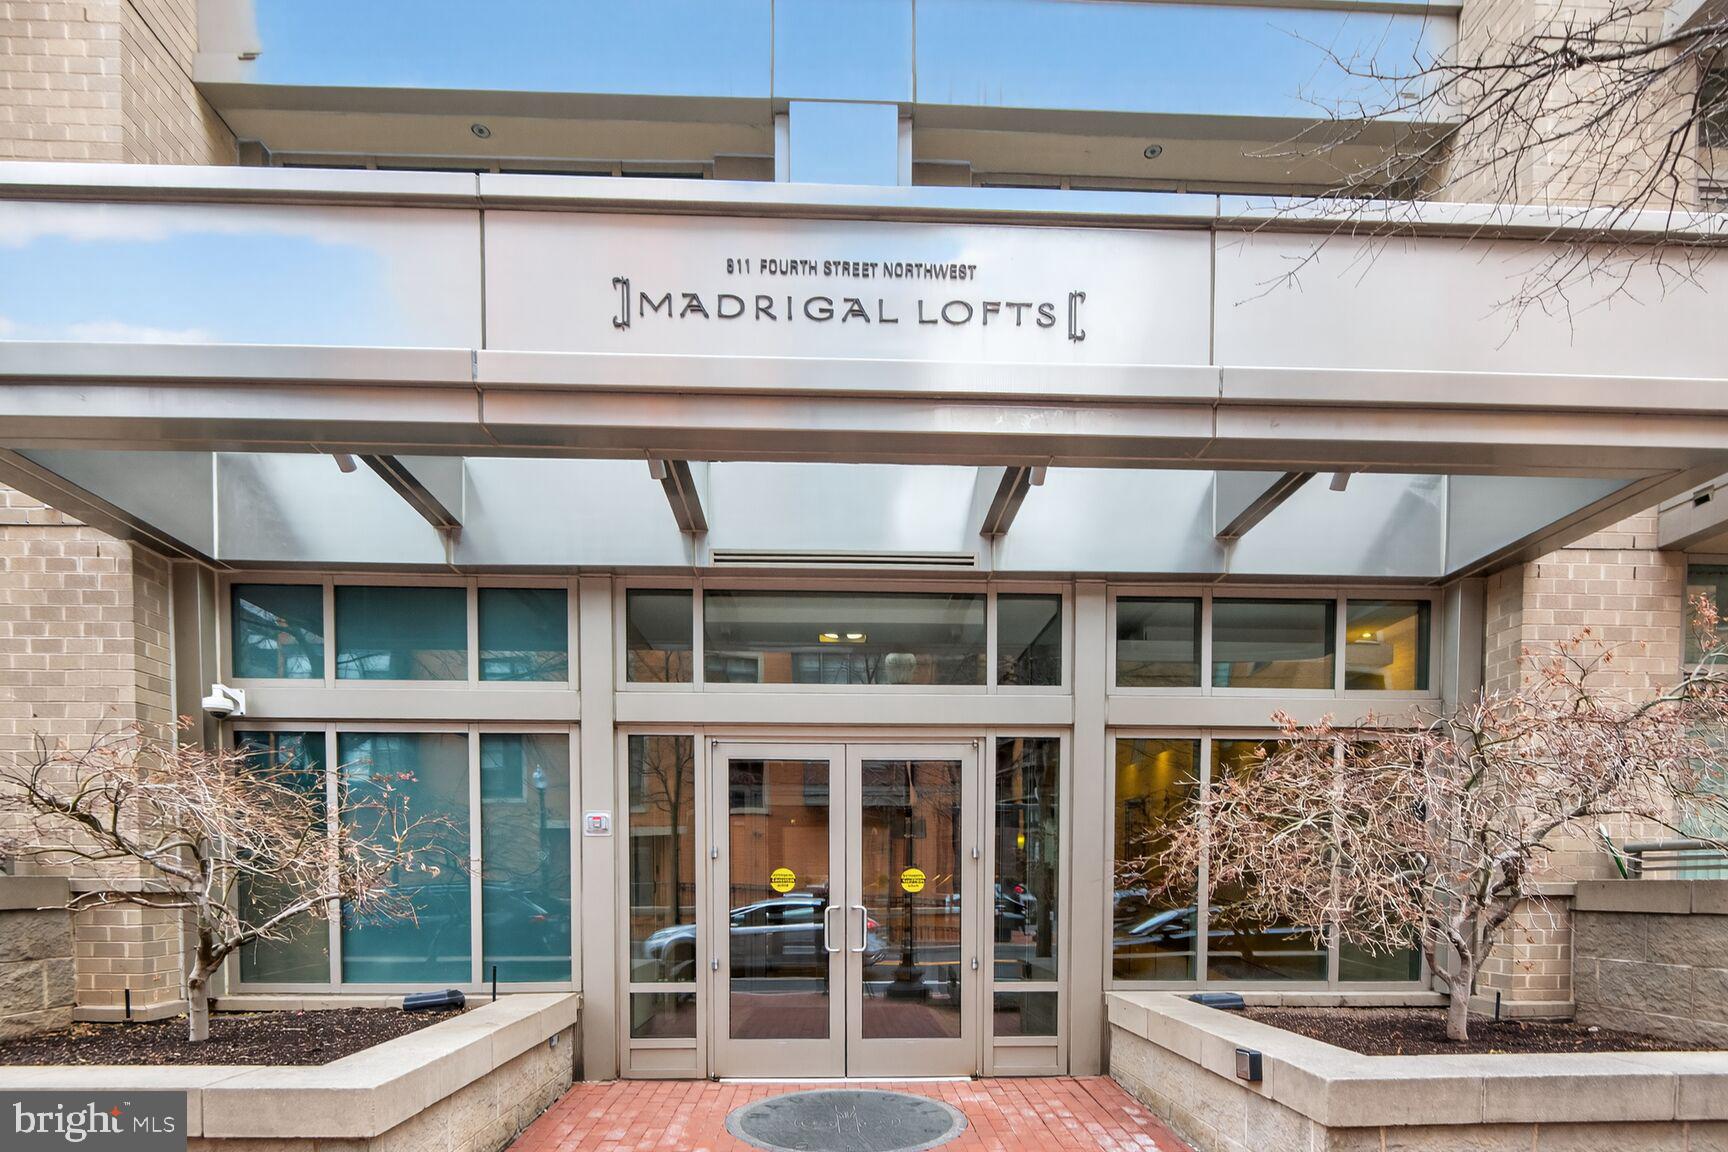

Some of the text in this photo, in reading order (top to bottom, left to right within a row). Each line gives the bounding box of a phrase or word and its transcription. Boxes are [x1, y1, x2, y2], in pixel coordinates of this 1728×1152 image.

[726, 258, 977, 281] 811 FOURTH STREET NORTHWEST
[638, 291, 1056, 328] MADRIGAL LOFTS
